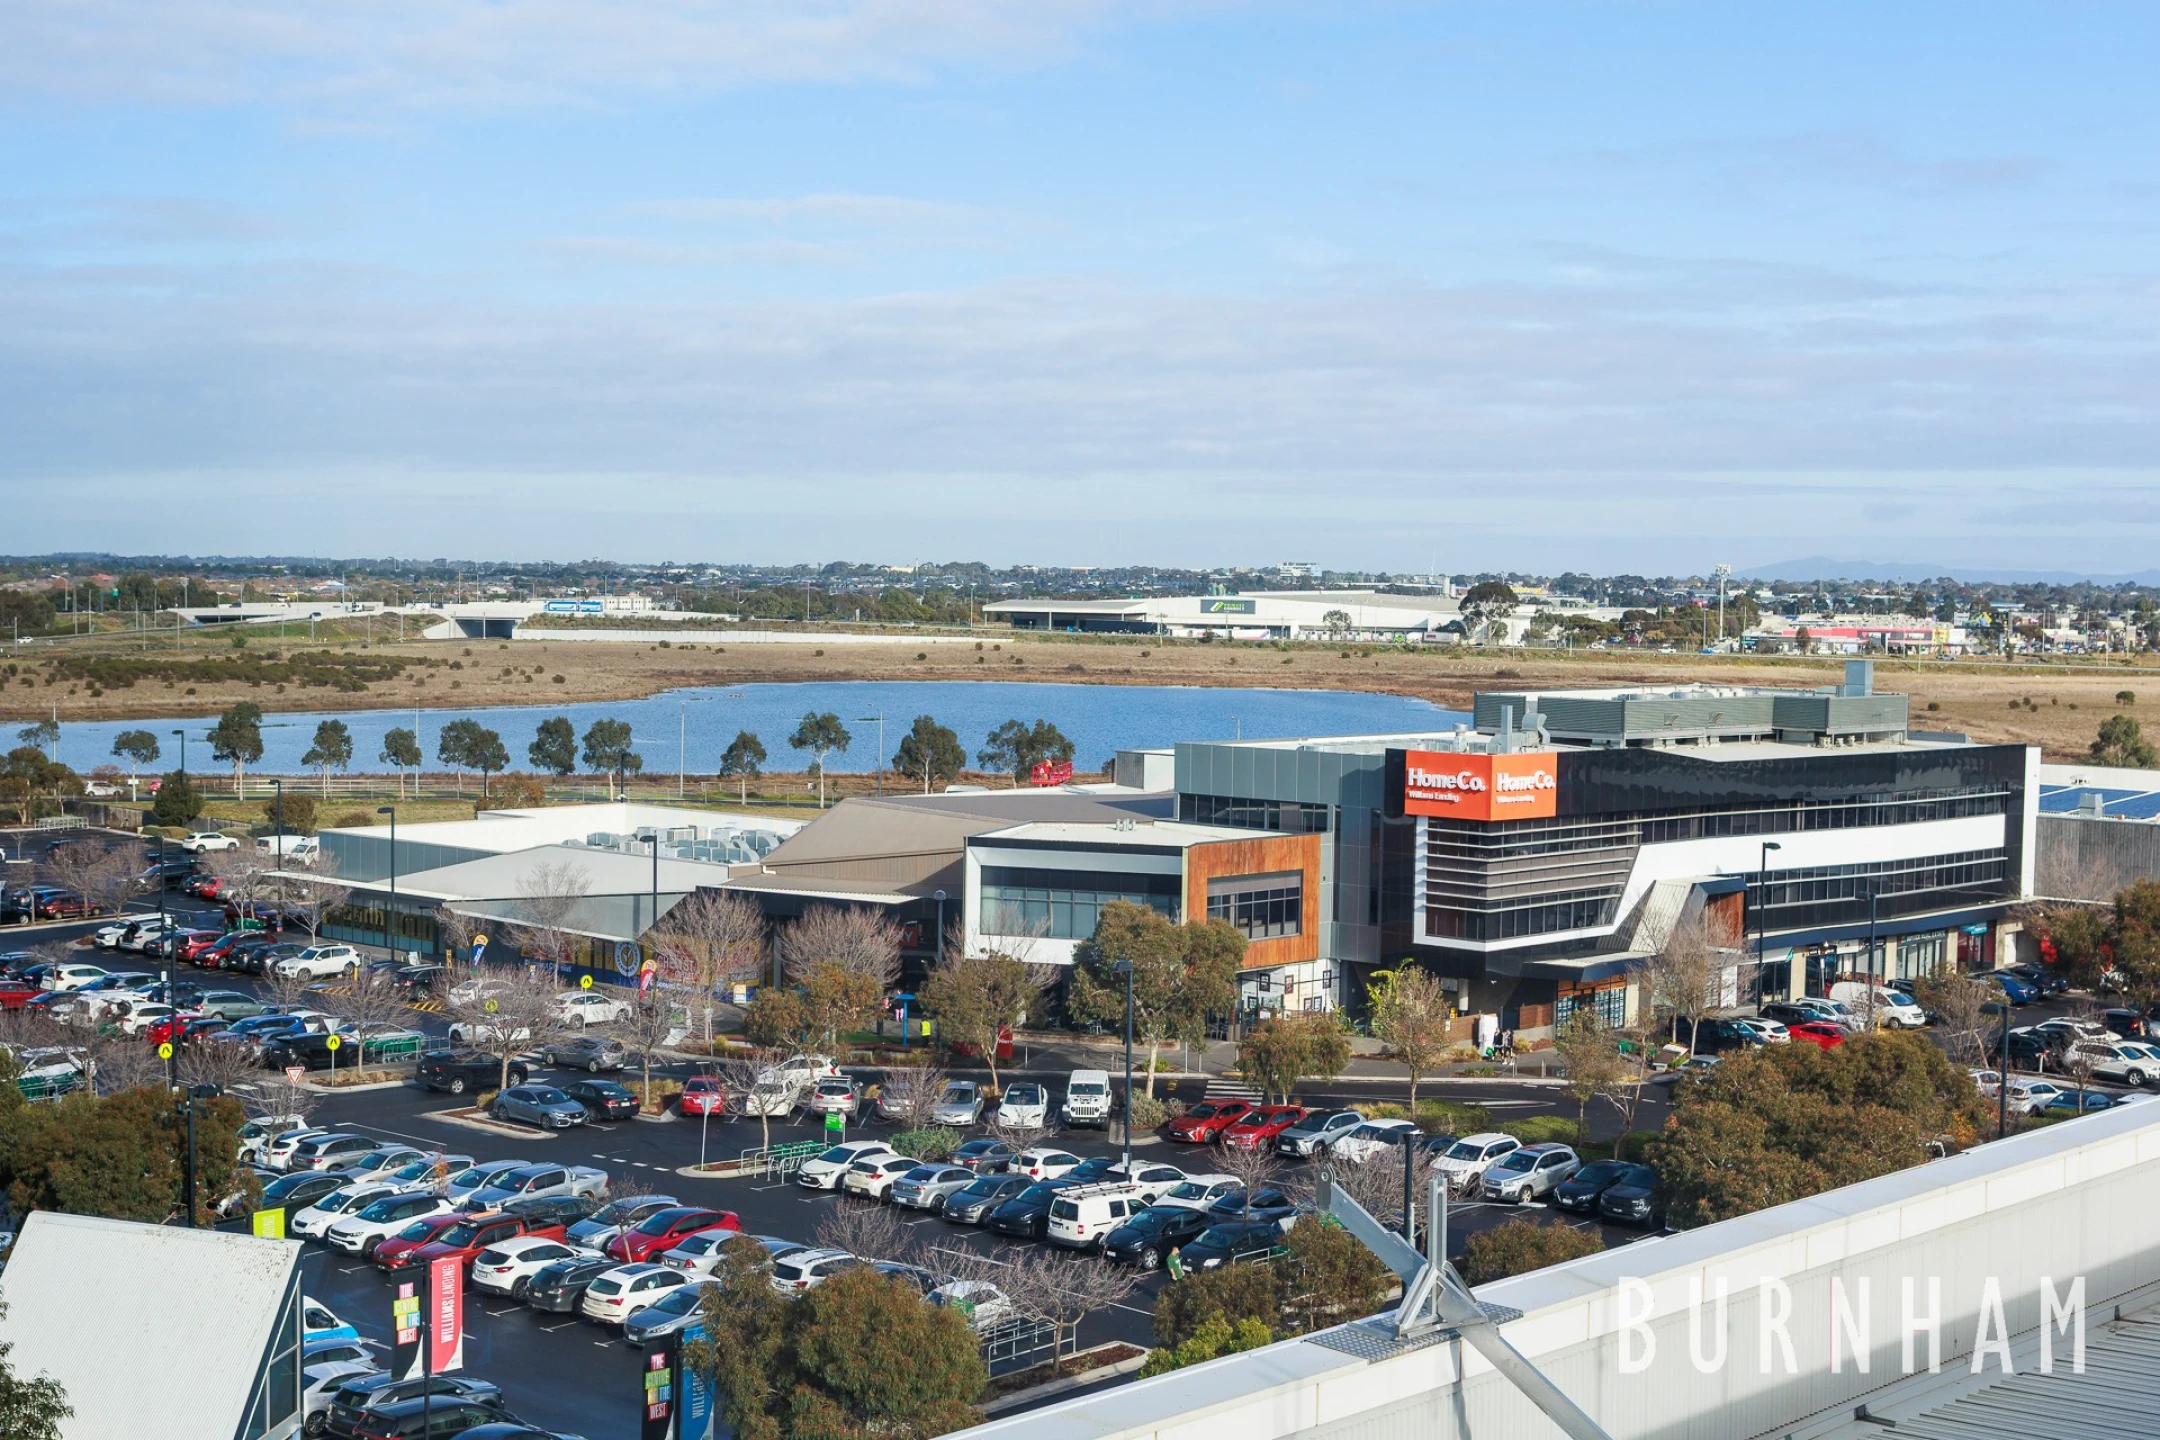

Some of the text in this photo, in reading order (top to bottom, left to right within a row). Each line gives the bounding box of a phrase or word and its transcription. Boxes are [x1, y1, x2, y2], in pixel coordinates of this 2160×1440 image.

[1408, 768, 1486, 791] HomeCo.
[1408, 790, 1459, 803] Williams Landing
[408, 1312, 420, 1327] THE
[399, 1328, 416, 1344] WEST
[653, 1355, 664, 1369] THE
[659, 1386, 671, 1401] THE
[650, 1402, 667, 1419] WEST
